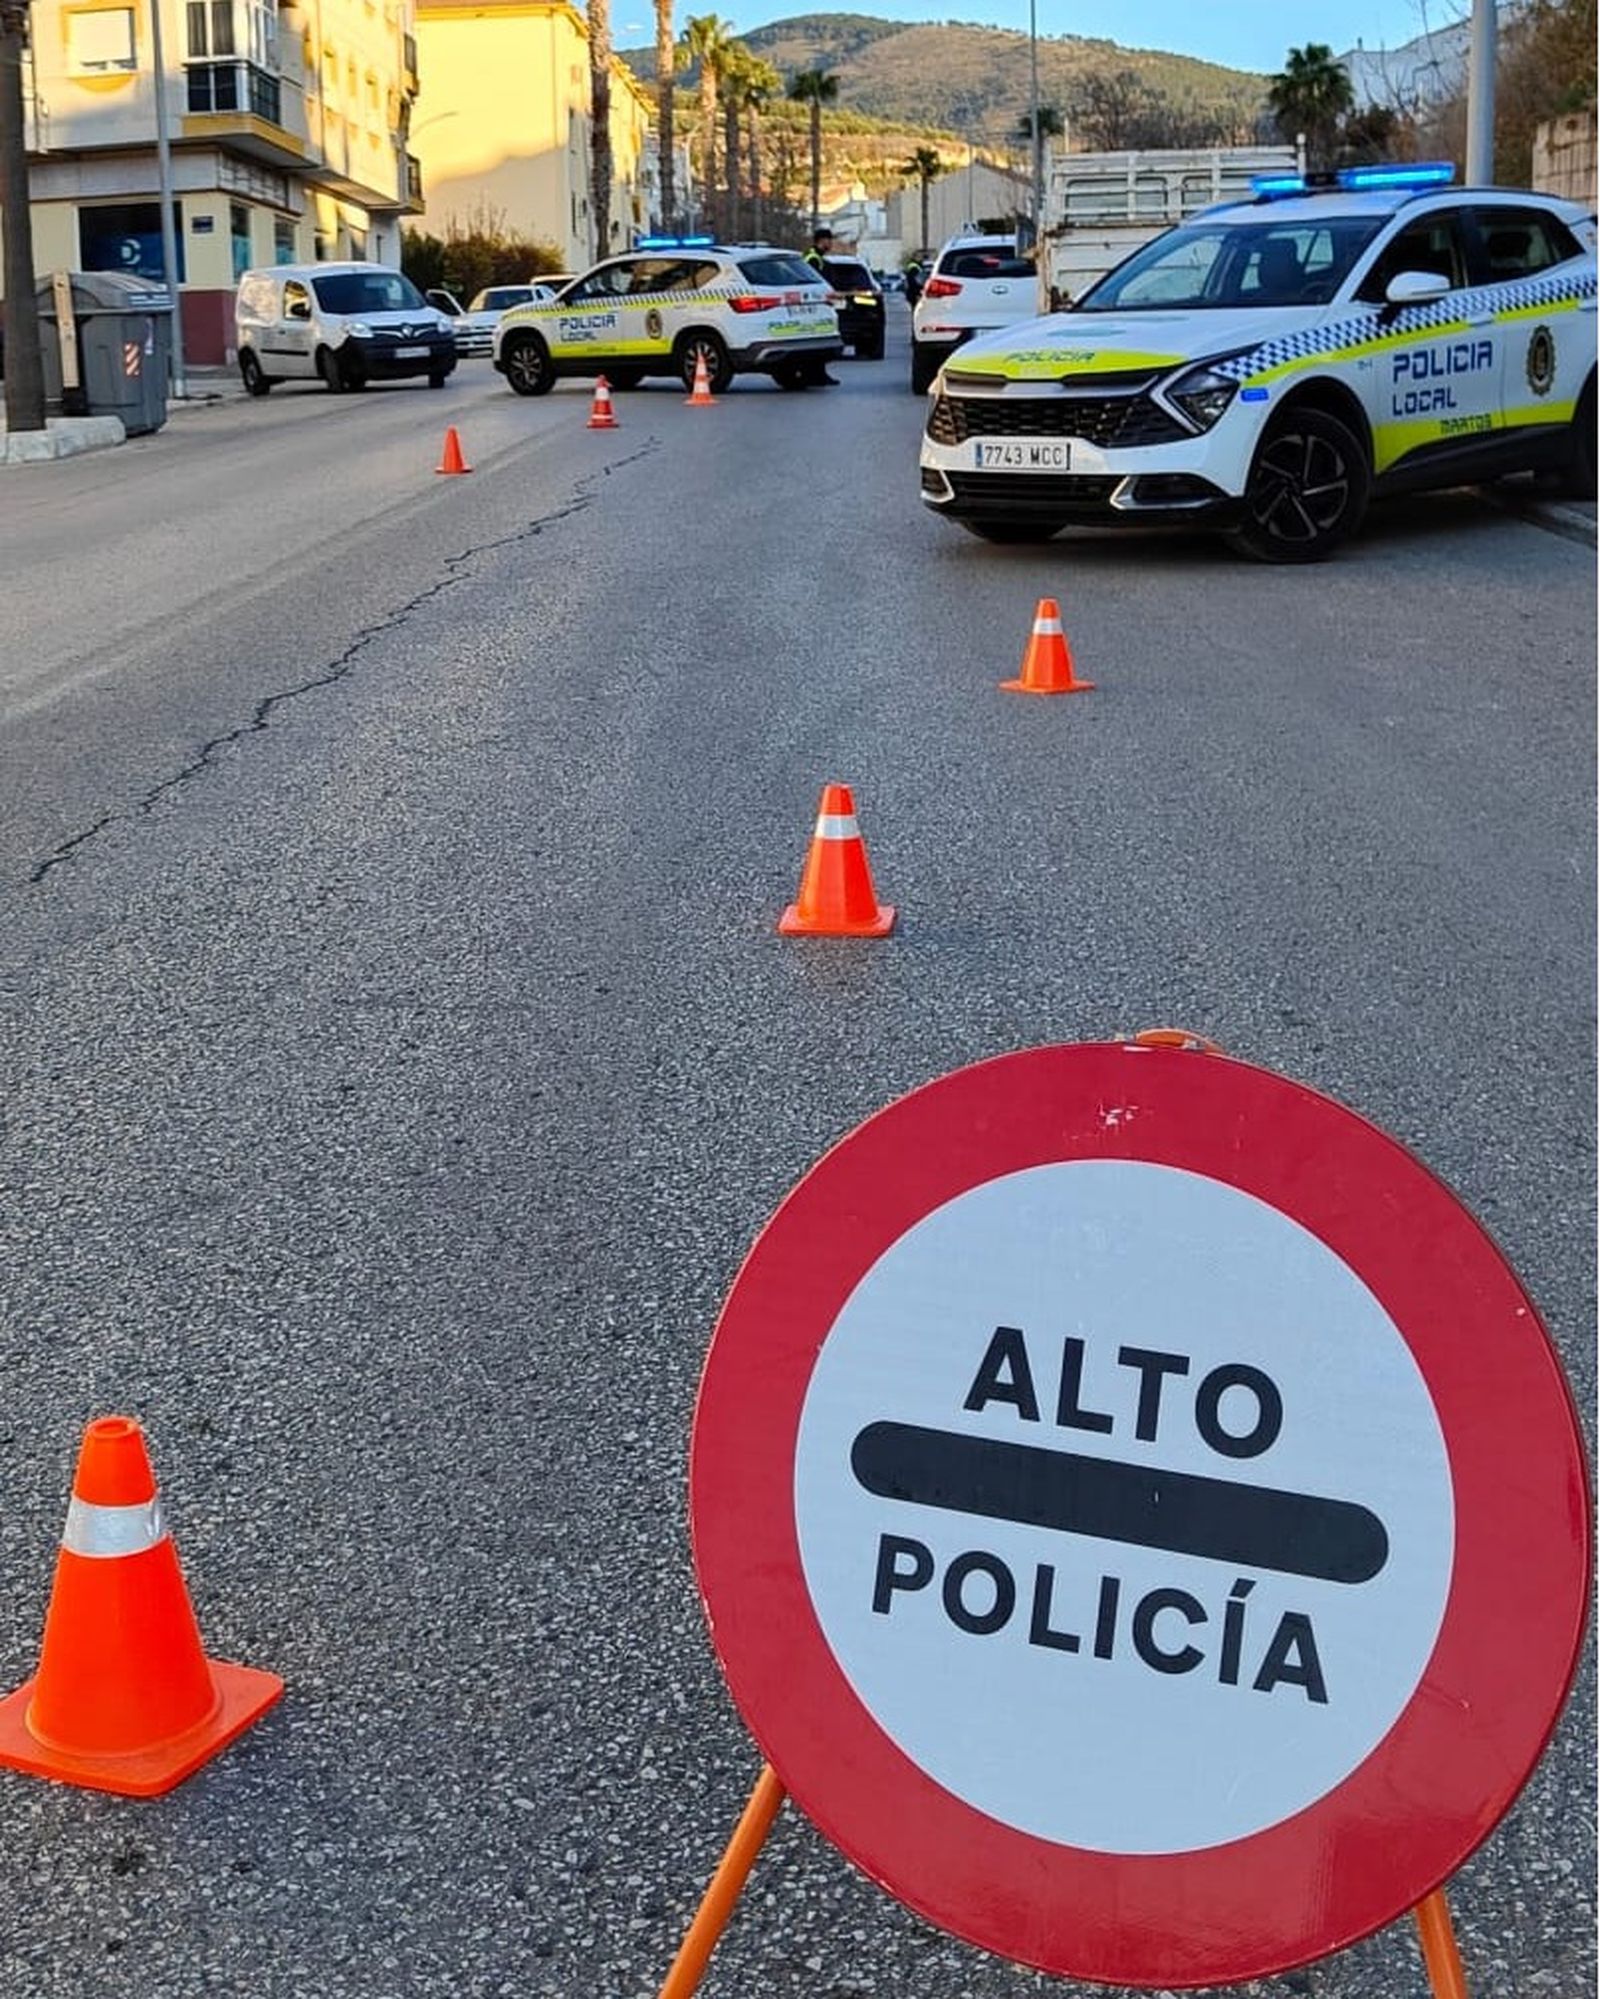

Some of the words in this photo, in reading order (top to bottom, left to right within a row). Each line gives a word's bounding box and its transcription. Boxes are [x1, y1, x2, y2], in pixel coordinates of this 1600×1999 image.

[559, 314, 616, 330] POLICIA
[1004, 350, 1095, 363] POLICIA
[1393, 340, 1493, 384] POLICIA
[1393, 387, 1458, 416] LOCAL
[1440, 413, 1492, 434] MARTOS
[984, 445, 1022, 465] 7743
[1030, 446, 1062, 465] MCC
[964, 1326, 1284, 1459] ALTO
[872, 1533, 1330, 1705] POLICÍA
